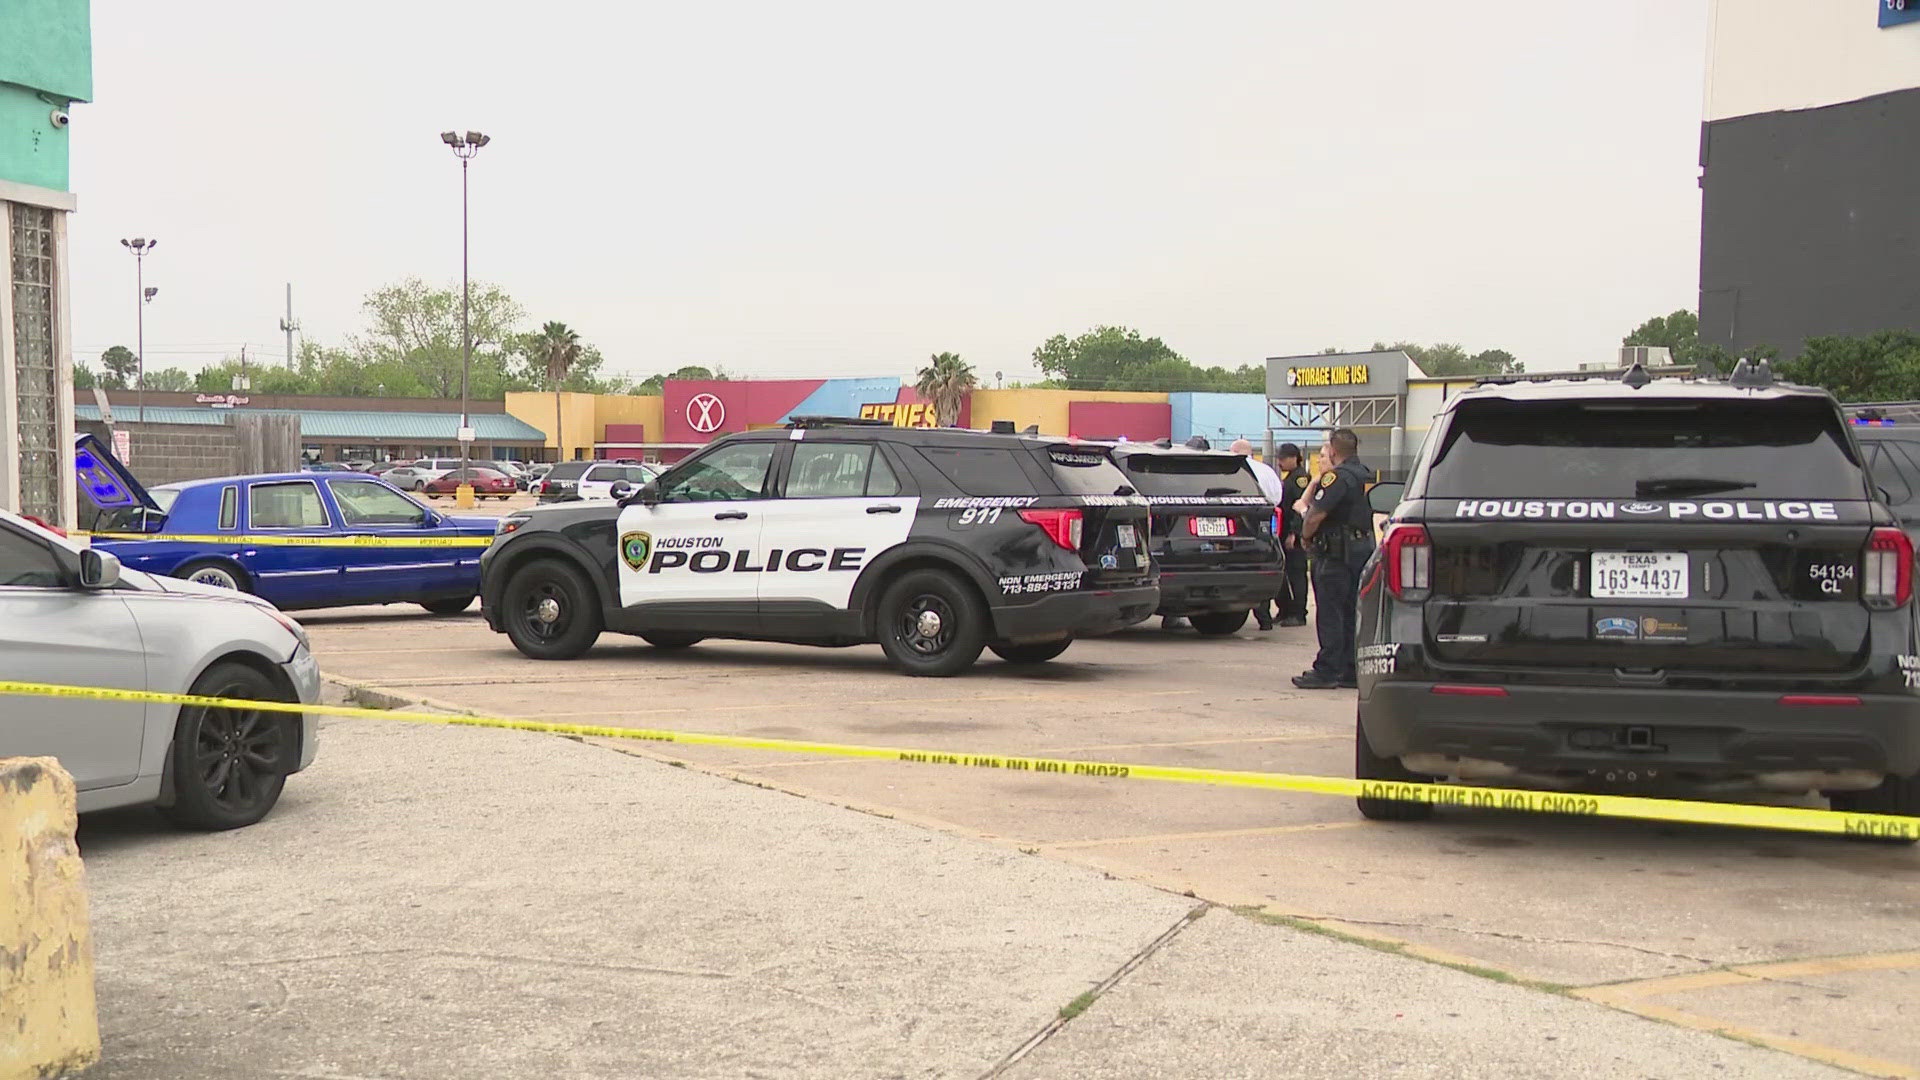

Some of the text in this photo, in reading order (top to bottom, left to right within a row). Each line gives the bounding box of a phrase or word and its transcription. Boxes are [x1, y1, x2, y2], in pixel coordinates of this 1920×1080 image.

[1296, 364, 1368, 386] STORAGE KING USA
[861, 403, 940, 428] FITNES
[933, 497, 1039, 508] EMERGENCY
[1149, 496, 1207, 505] HOUSTON
[1220, 496, 1268, 505] POLICE
[958, 508, 1002, 524] 911
[1455, 501, 1615, 518] HOUSTON
[1669, 502, 1839, 519] POLICE
[656, 537, 723, 548] HOUSTON
[649, 548, 866, 574] POLICE
[1621, 555, 1658, 564] TEXAS
[998, 571, 1083, 585] NON EMERGENCY
[1809, 564, 1854, 579] 54134
[1002, 579, 1081, 595] 713-884-3131
[1821, 579, 1842, 593] CL
